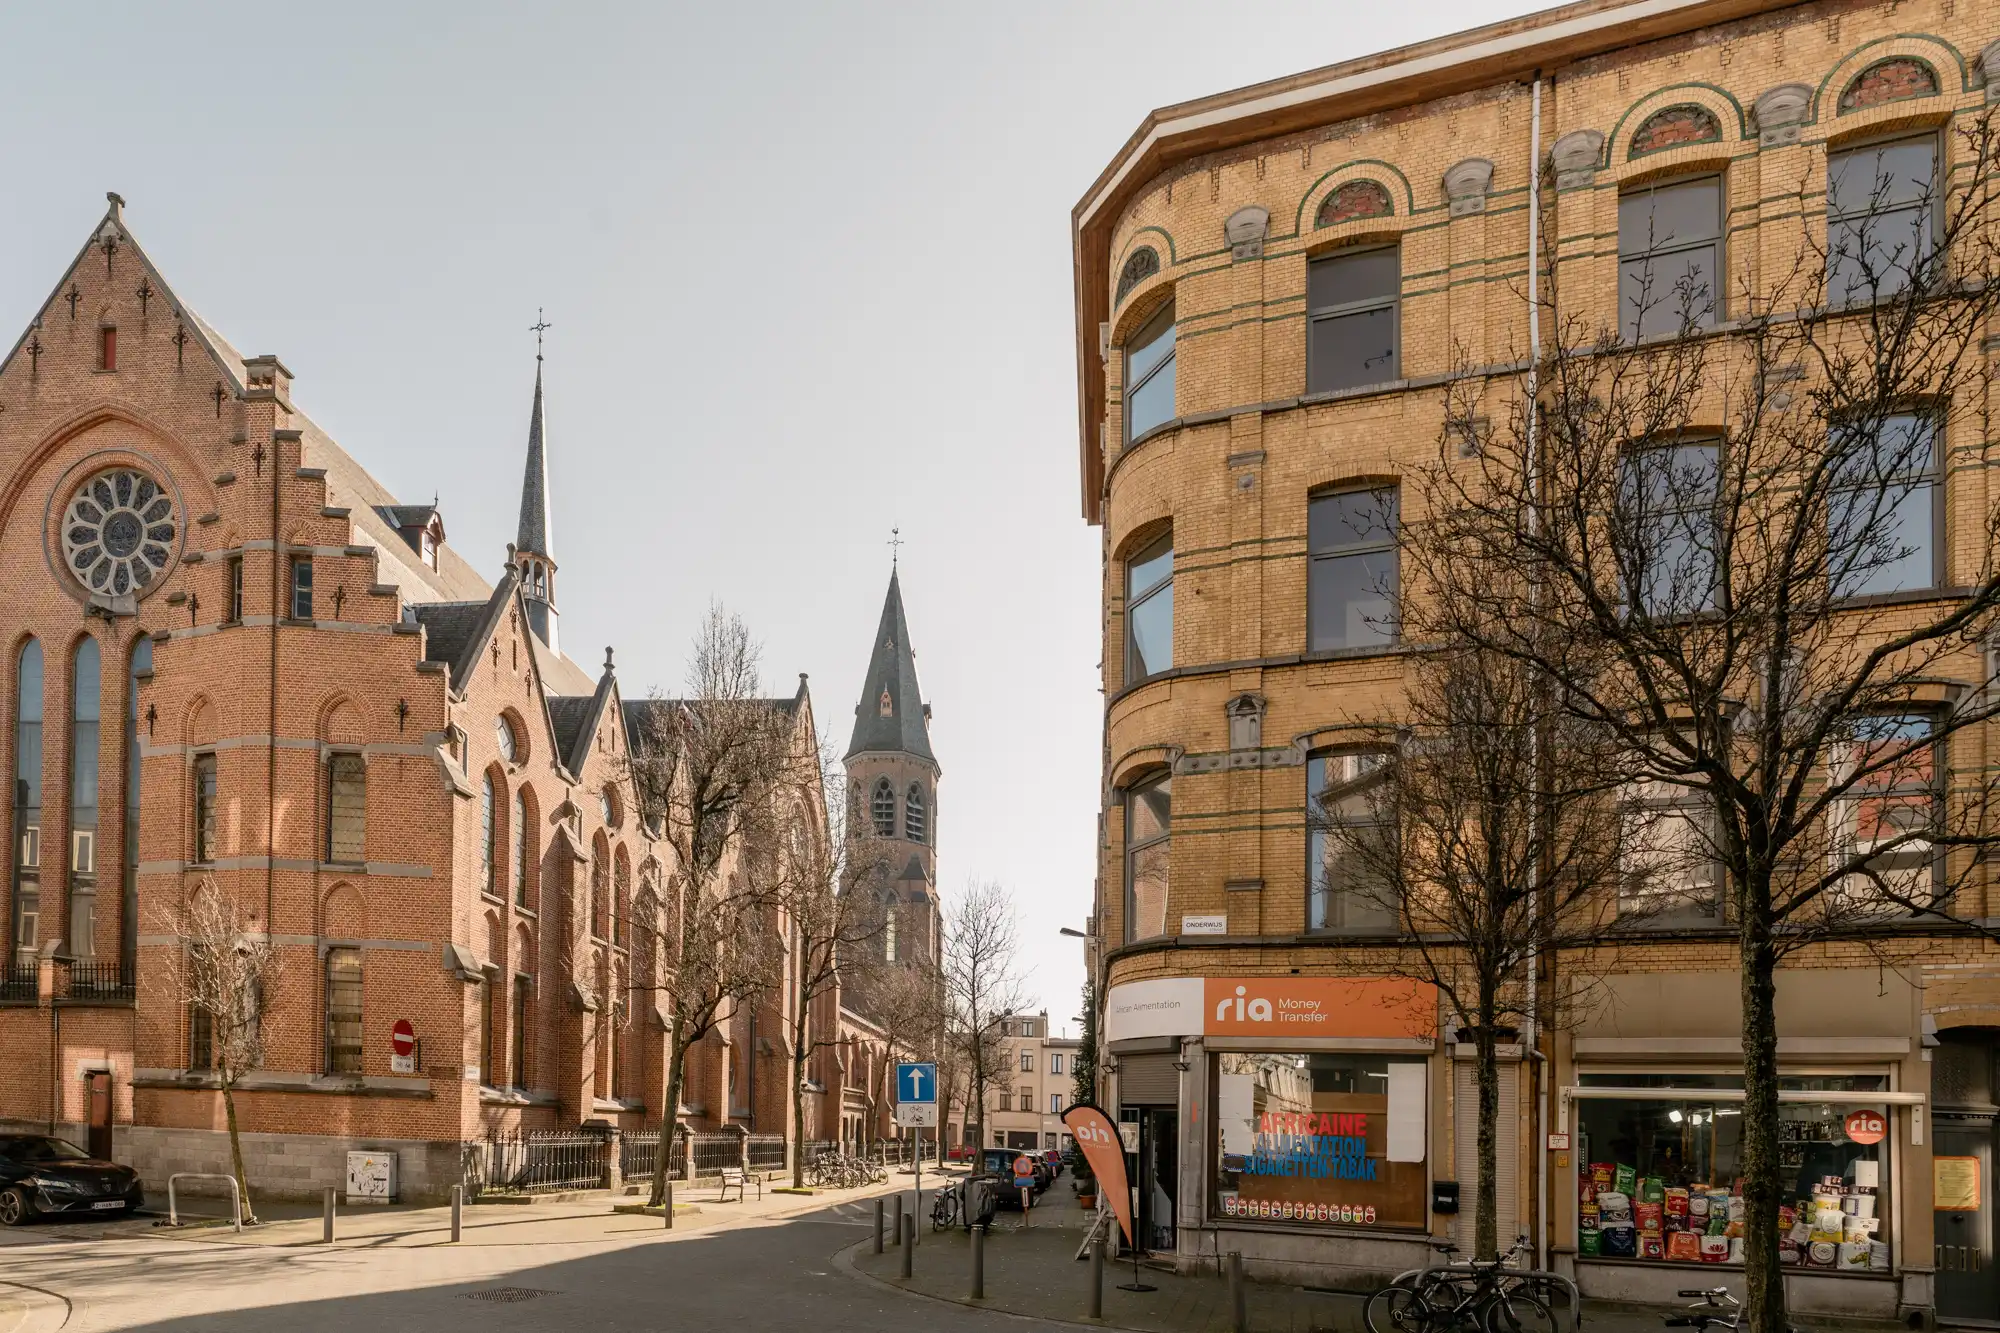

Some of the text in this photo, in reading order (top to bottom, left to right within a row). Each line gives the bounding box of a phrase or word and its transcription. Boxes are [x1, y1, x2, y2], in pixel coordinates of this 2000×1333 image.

[1133, 1000, 1181, 1012] Alimentation
[1216, 986, 1272, 1022] ria
[1278, 998, 1320, 1012] Money
[1278, 1012, 1328, 1022] Transfer
[1260, 1112, 1367, 1136] AFRICAINE
[1850, 1114, 1882, 1132] ria
[1255, 1134, 1366, 1158] ALIMENTATION
[1244, 1155, 1376, 1182] SIGARETTEN-TABAK
